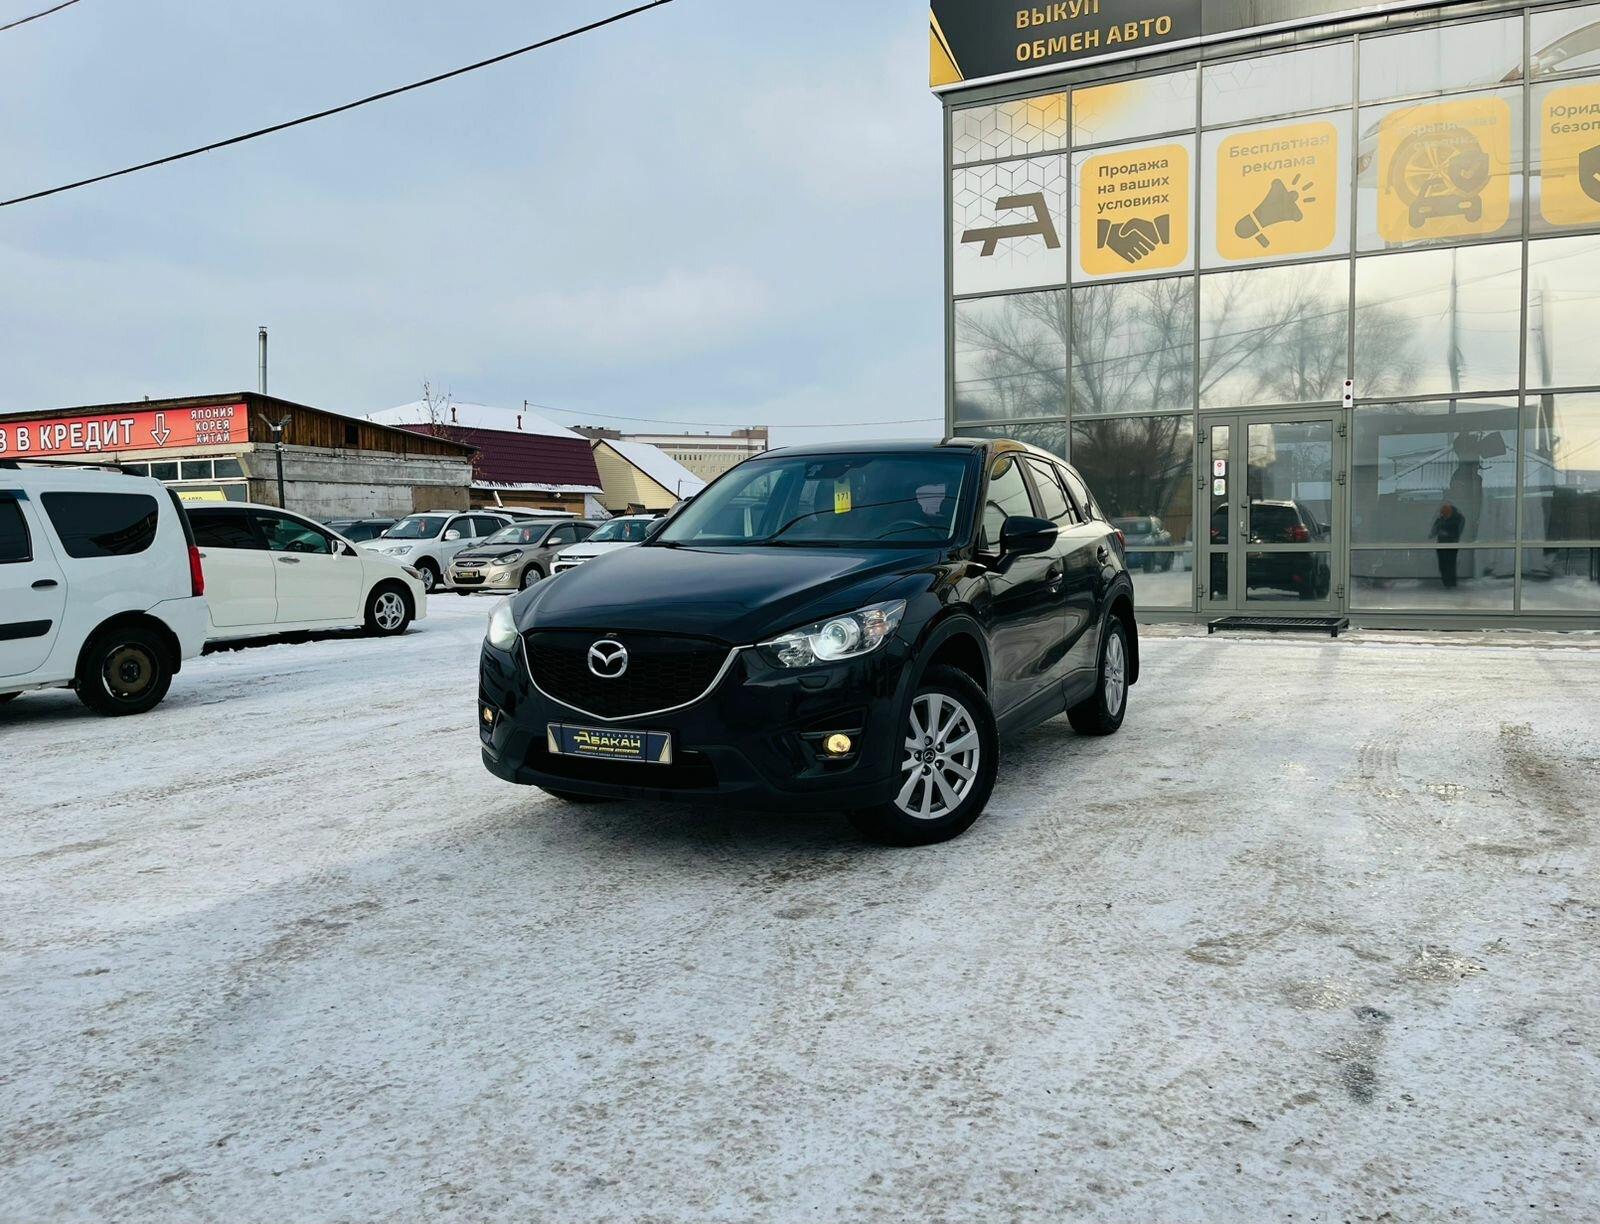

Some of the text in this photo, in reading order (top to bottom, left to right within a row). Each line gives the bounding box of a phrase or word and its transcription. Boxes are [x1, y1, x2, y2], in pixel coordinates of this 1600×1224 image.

[1016, 0, 1101, 29] ВЫКУП
[1016, 15, 1172, 62] ОБМЕН АВТО
[1229, 135, 1330, 158] Бесплатная
[1098, 159, 1169, 178] Продажа
[1242, 155, 1316, 177] реклама
[1097, 176, 1169, 194] на ваших
[1097, 194, 1169, 215] условиях
[190, 407, 235, 420] ЯПОНИЯ
[16, 427, 31, 451] В
[39, 418, 135, 452] КРЕДИТ
[195, 419, 231, 432] КОРЕЯ
[196, 431, 231, 445] КИТАЙ
